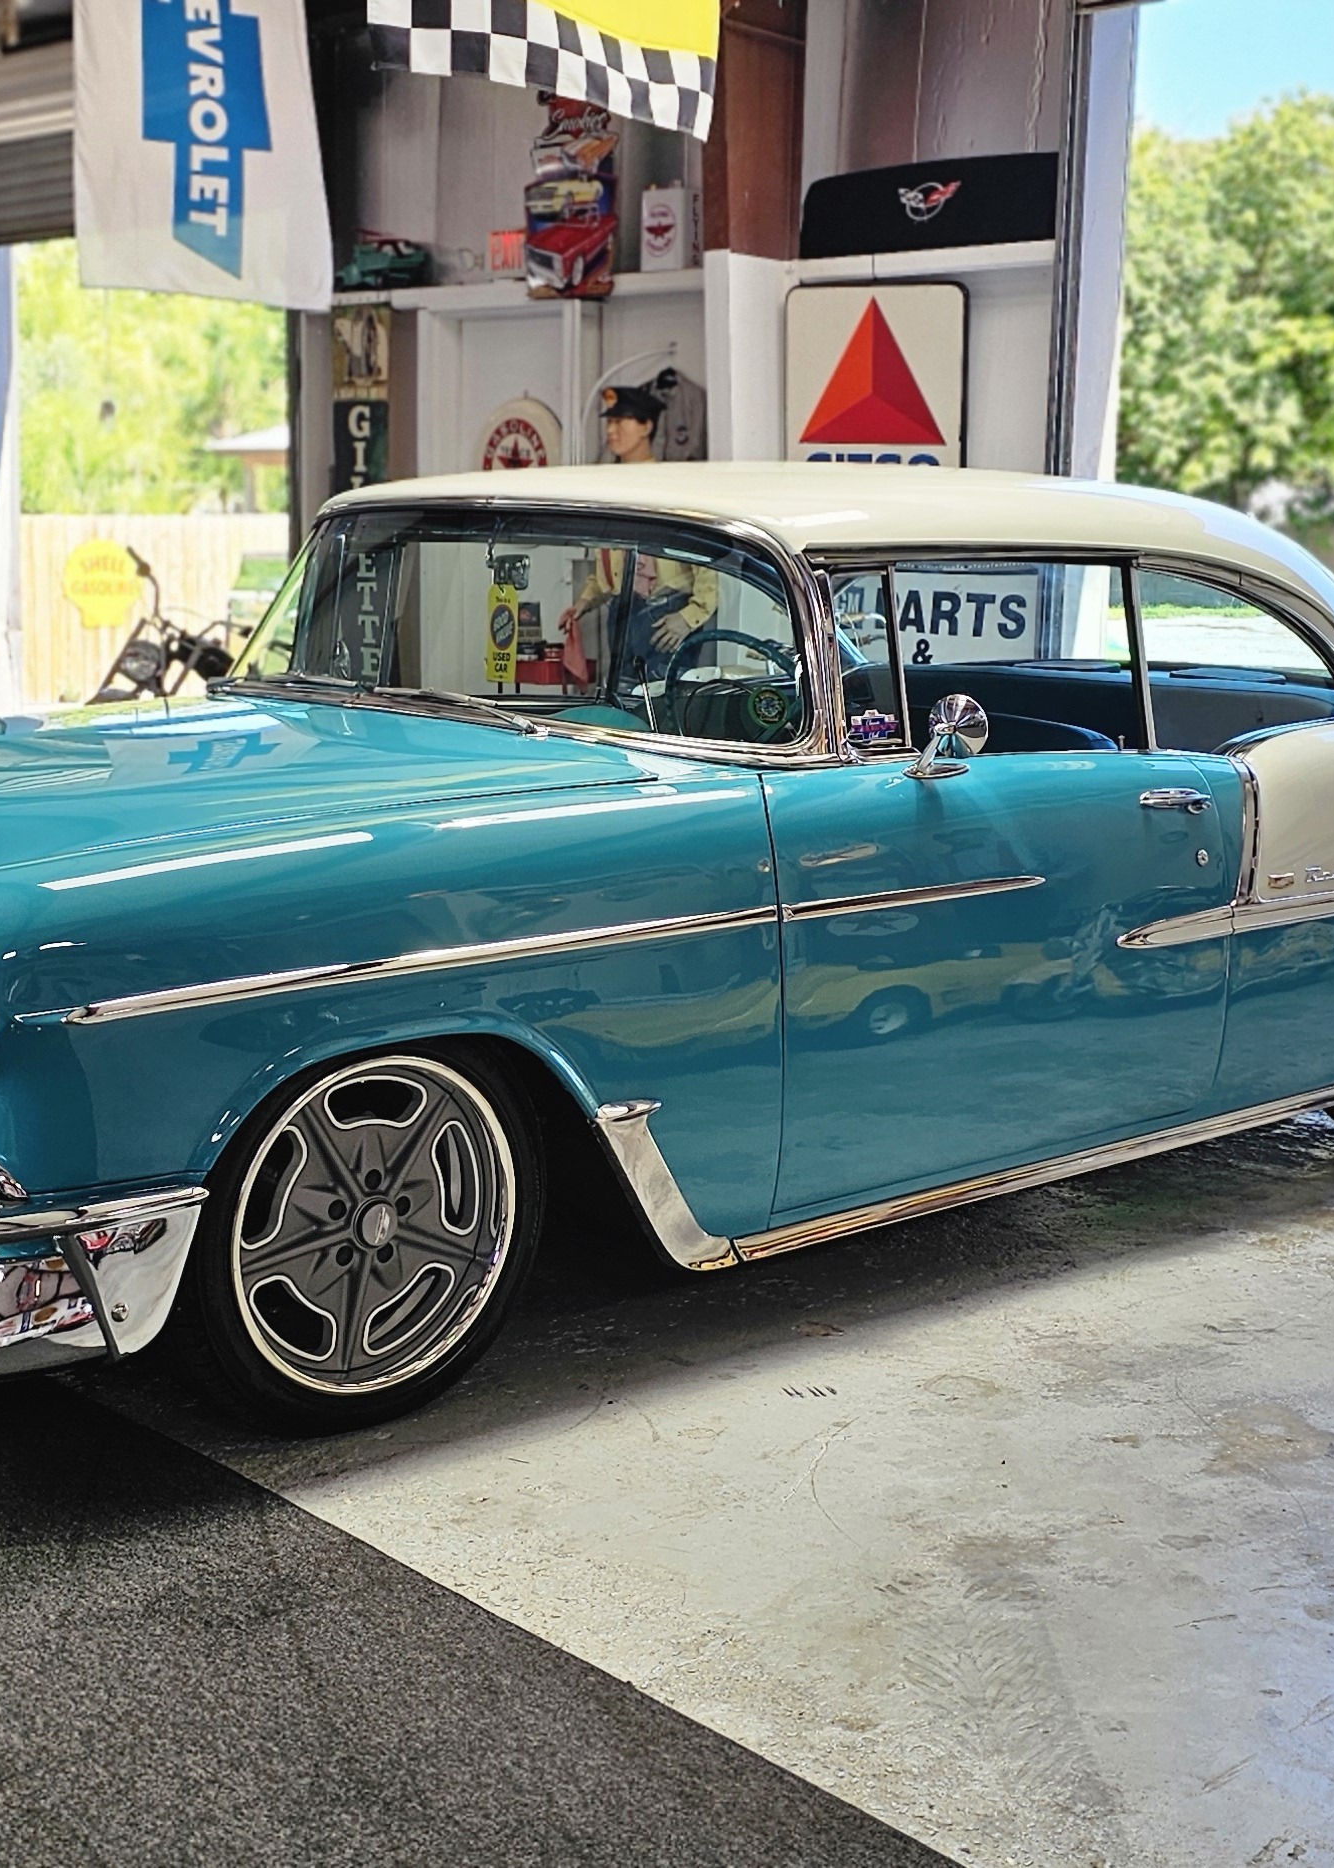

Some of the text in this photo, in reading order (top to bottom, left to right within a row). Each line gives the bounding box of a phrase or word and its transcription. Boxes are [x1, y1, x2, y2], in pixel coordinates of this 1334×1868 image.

[184, 0, 229, 237] EVROLET
[490, 230, 524, 271] EXIT
[487, 420, 545, 459] GASOLINE
[493, 652, 511, 661] USED
[912, 639, 933, 664] &
[495, 663, 508, 673] CAR
